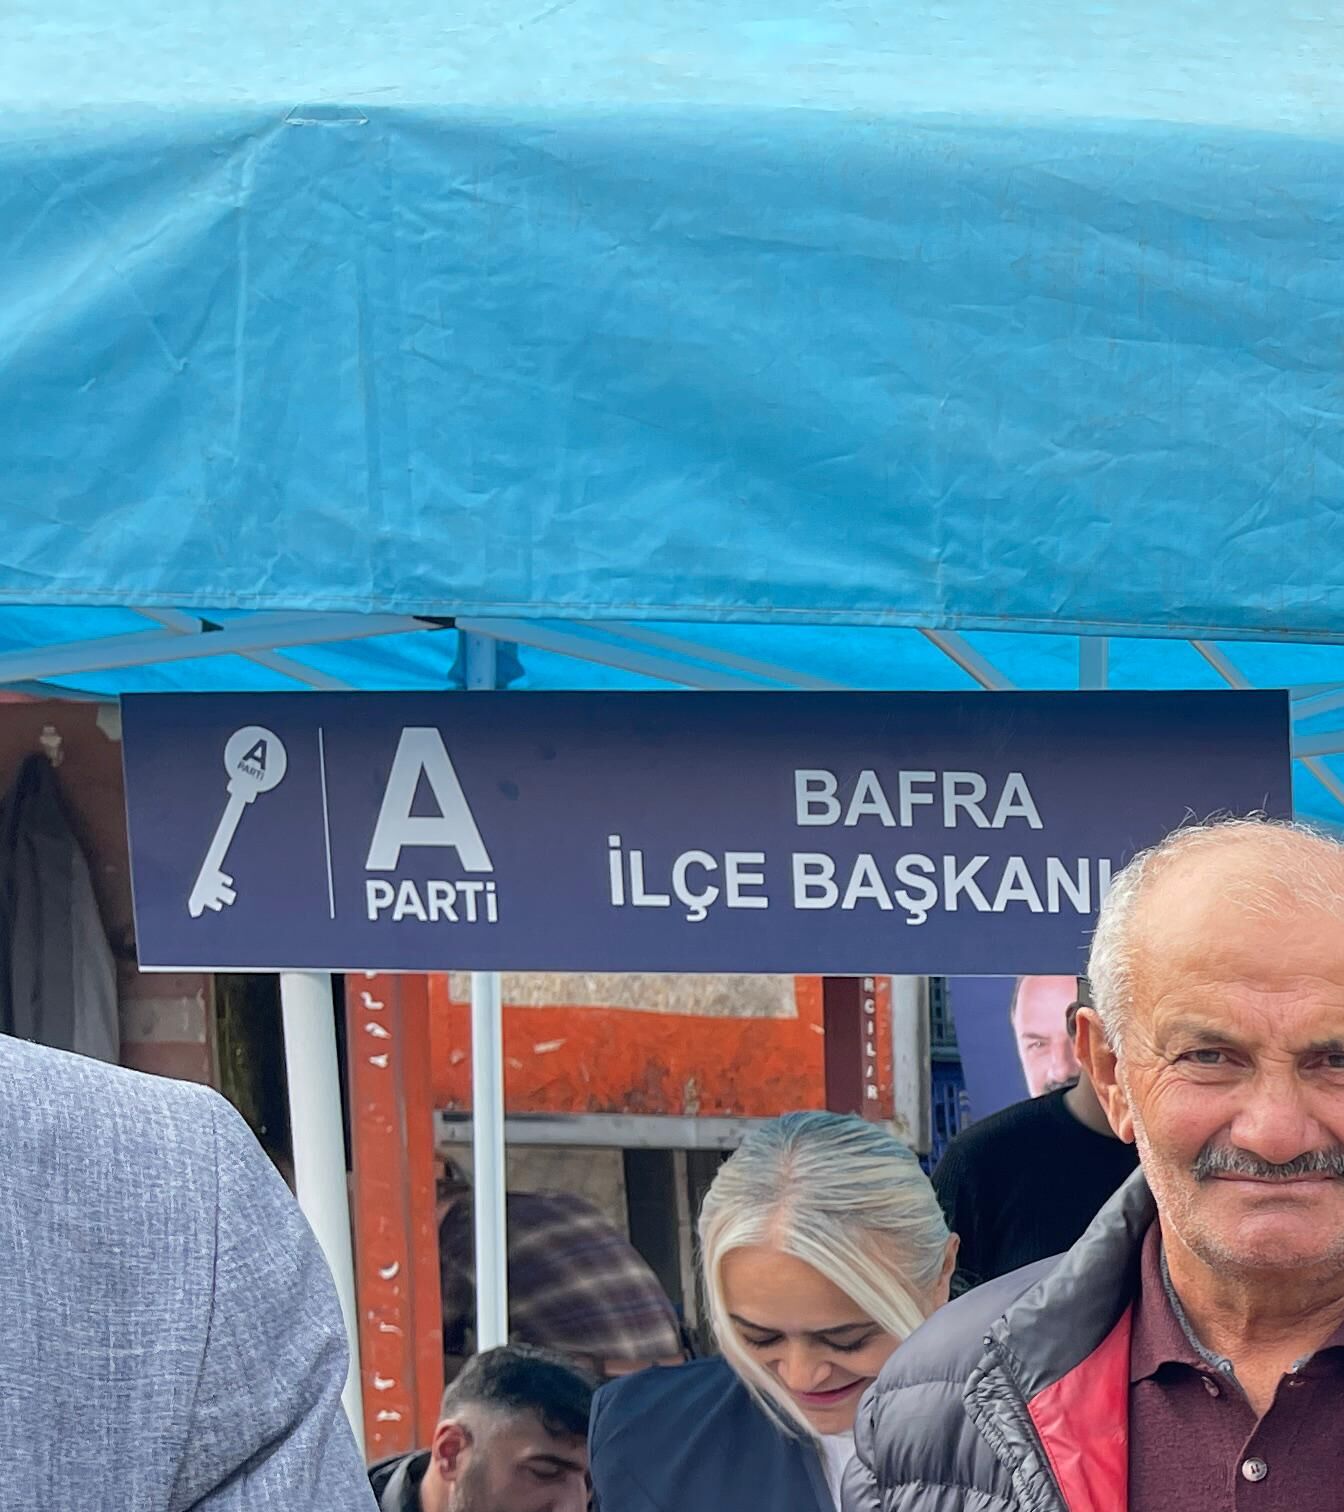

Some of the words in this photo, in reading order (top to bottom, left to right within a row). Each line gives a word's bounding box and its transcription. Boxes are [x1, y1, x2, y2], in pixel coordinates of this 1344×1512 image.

[242, 738, 267, 771] A
[365, 727, 494, 872] A
[795, 769, 1043, 829] BAFRA
[608, 834, 768, 922] İLÇE
